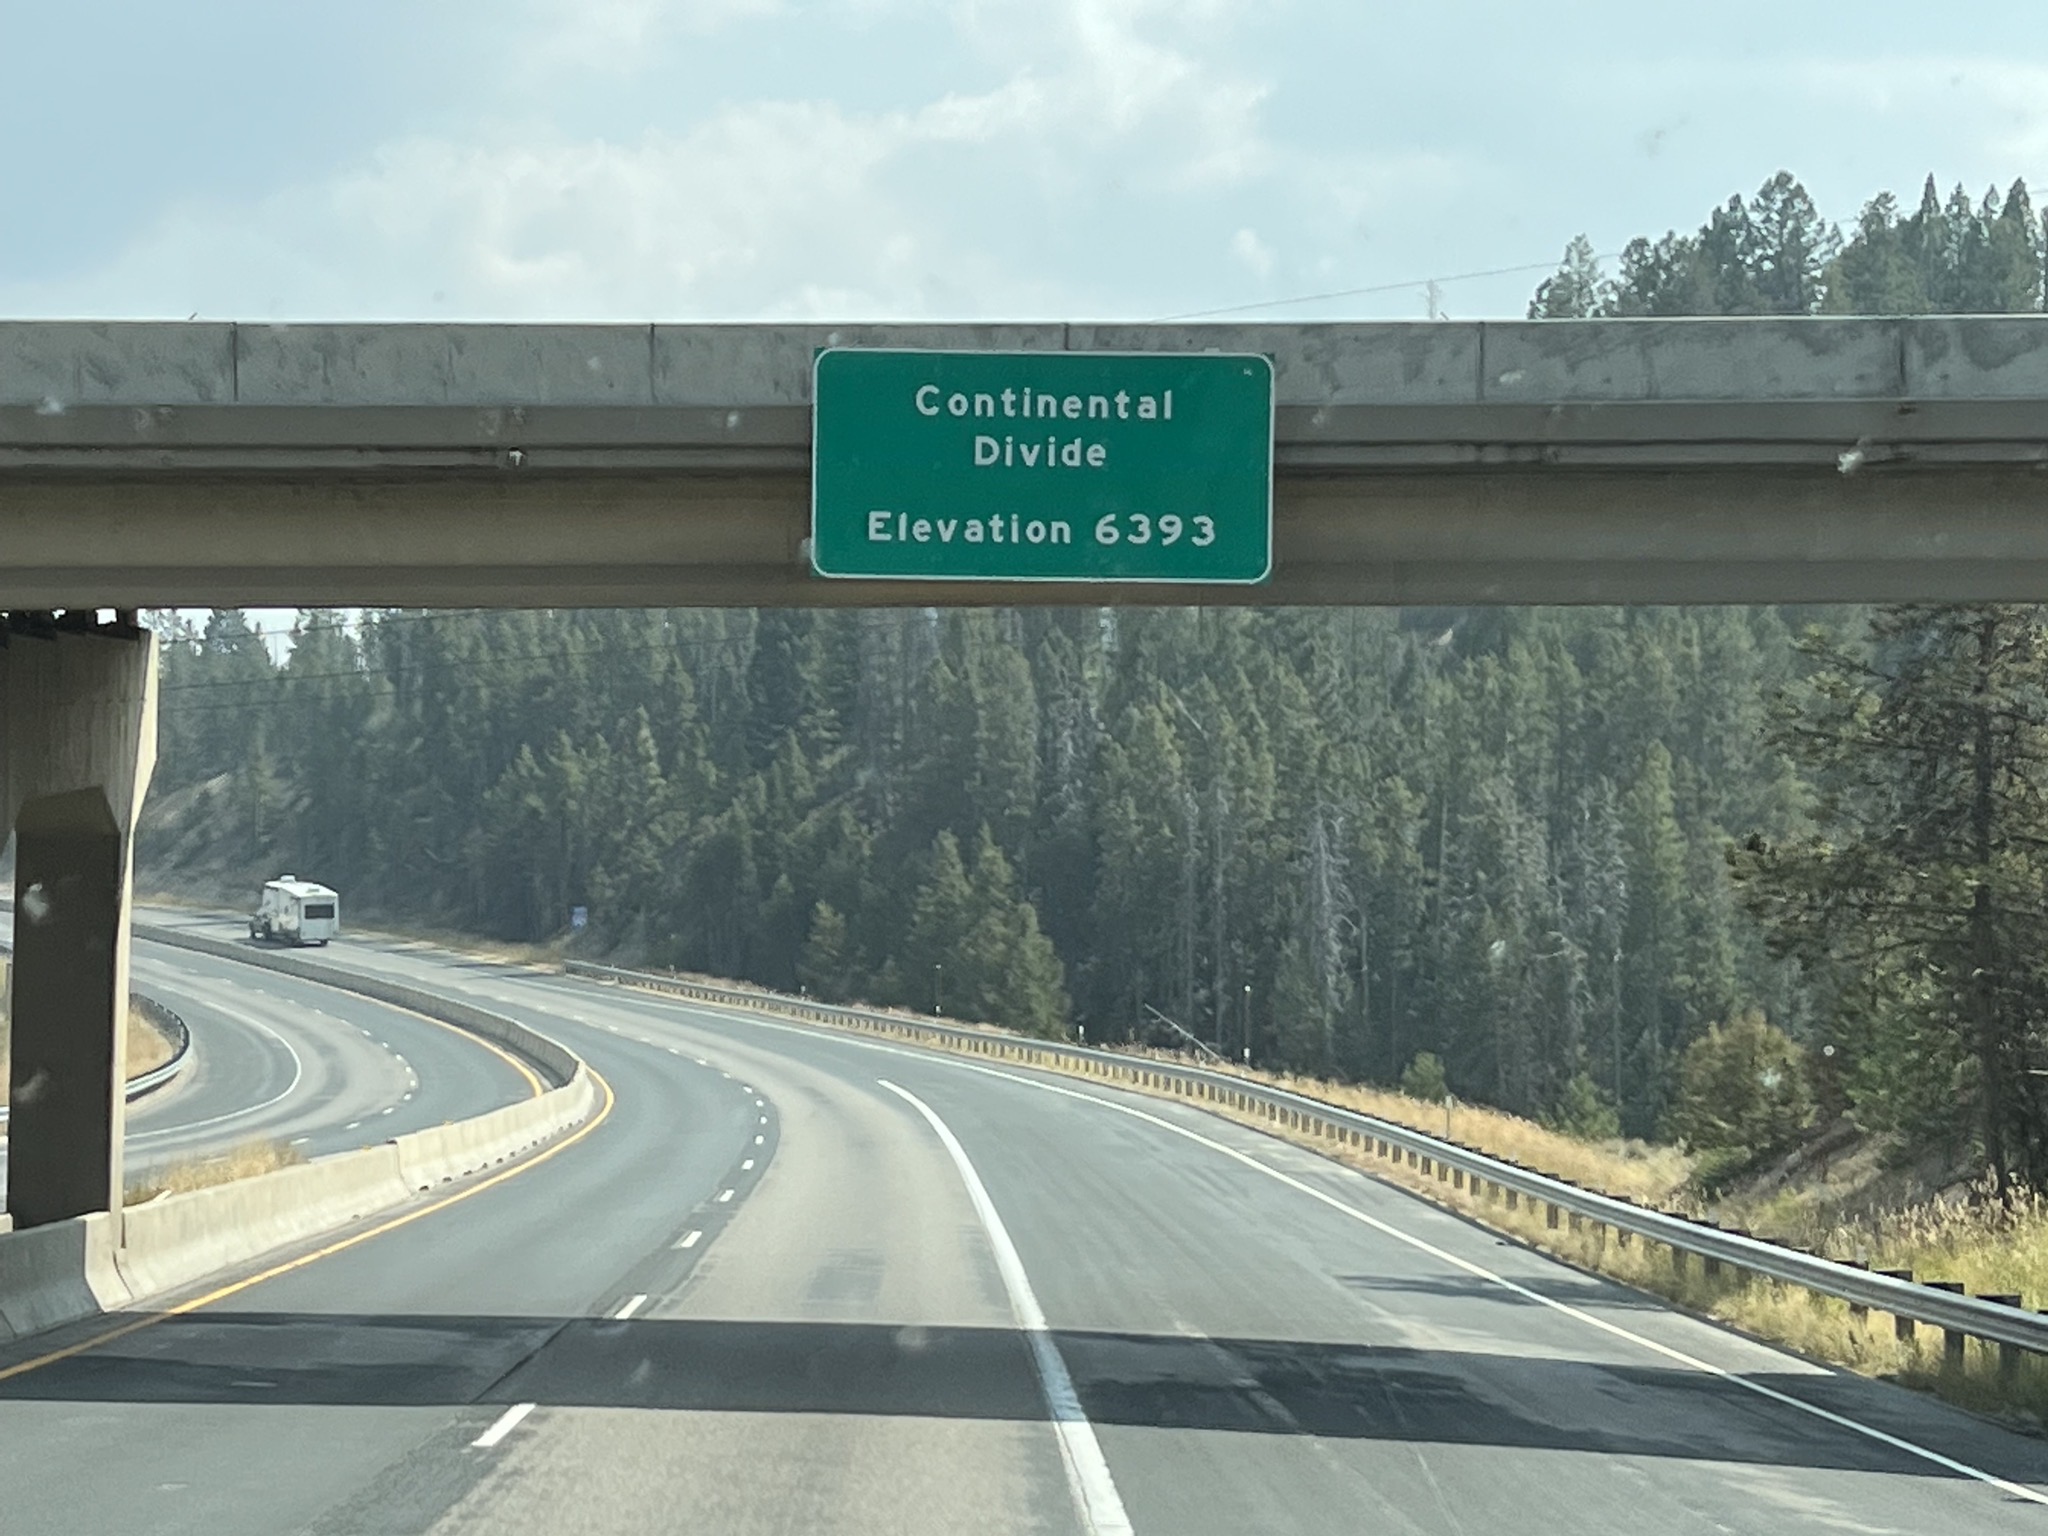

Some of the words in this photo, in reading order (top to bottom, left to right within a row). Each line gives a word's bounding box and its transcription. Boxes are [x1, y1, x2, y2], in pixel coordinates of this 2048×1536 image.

[915, 385, 1172, 420] Continental
[974, 435, 1107, 467] Divide
[868, 511, 1071, 544] Elevation
[1095, 513, 1216, 546] 6393
